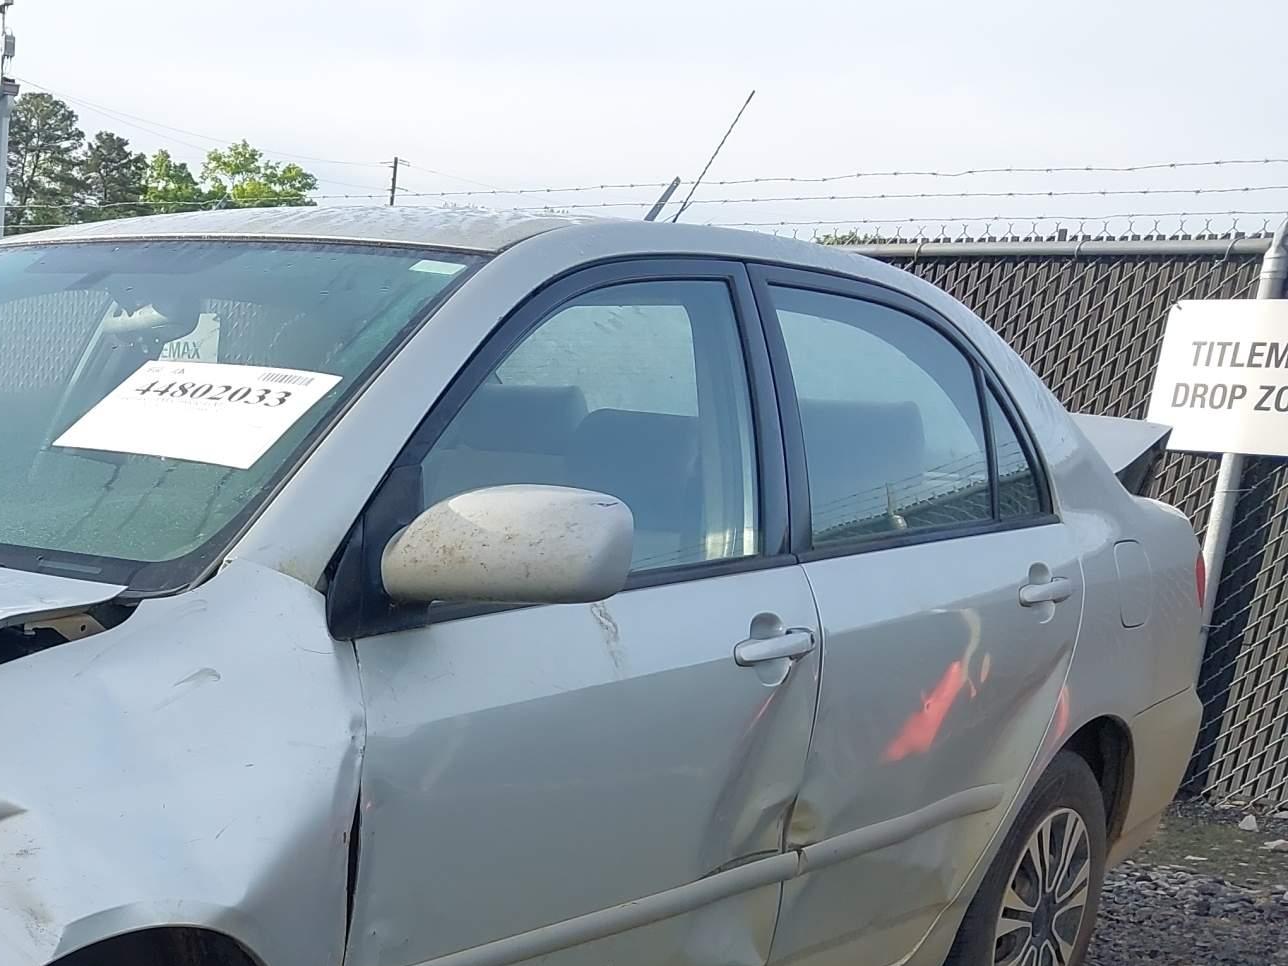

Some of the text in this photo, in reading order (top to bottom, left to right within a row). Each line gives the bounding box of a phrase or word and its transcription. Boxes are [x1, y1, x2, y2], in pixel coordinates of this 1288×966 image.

[1192, 342, 1288, 368] TITLEM
[135, 379, 292, 408] 44802033
[1171, 382, 1288, 412] DROP ZO
